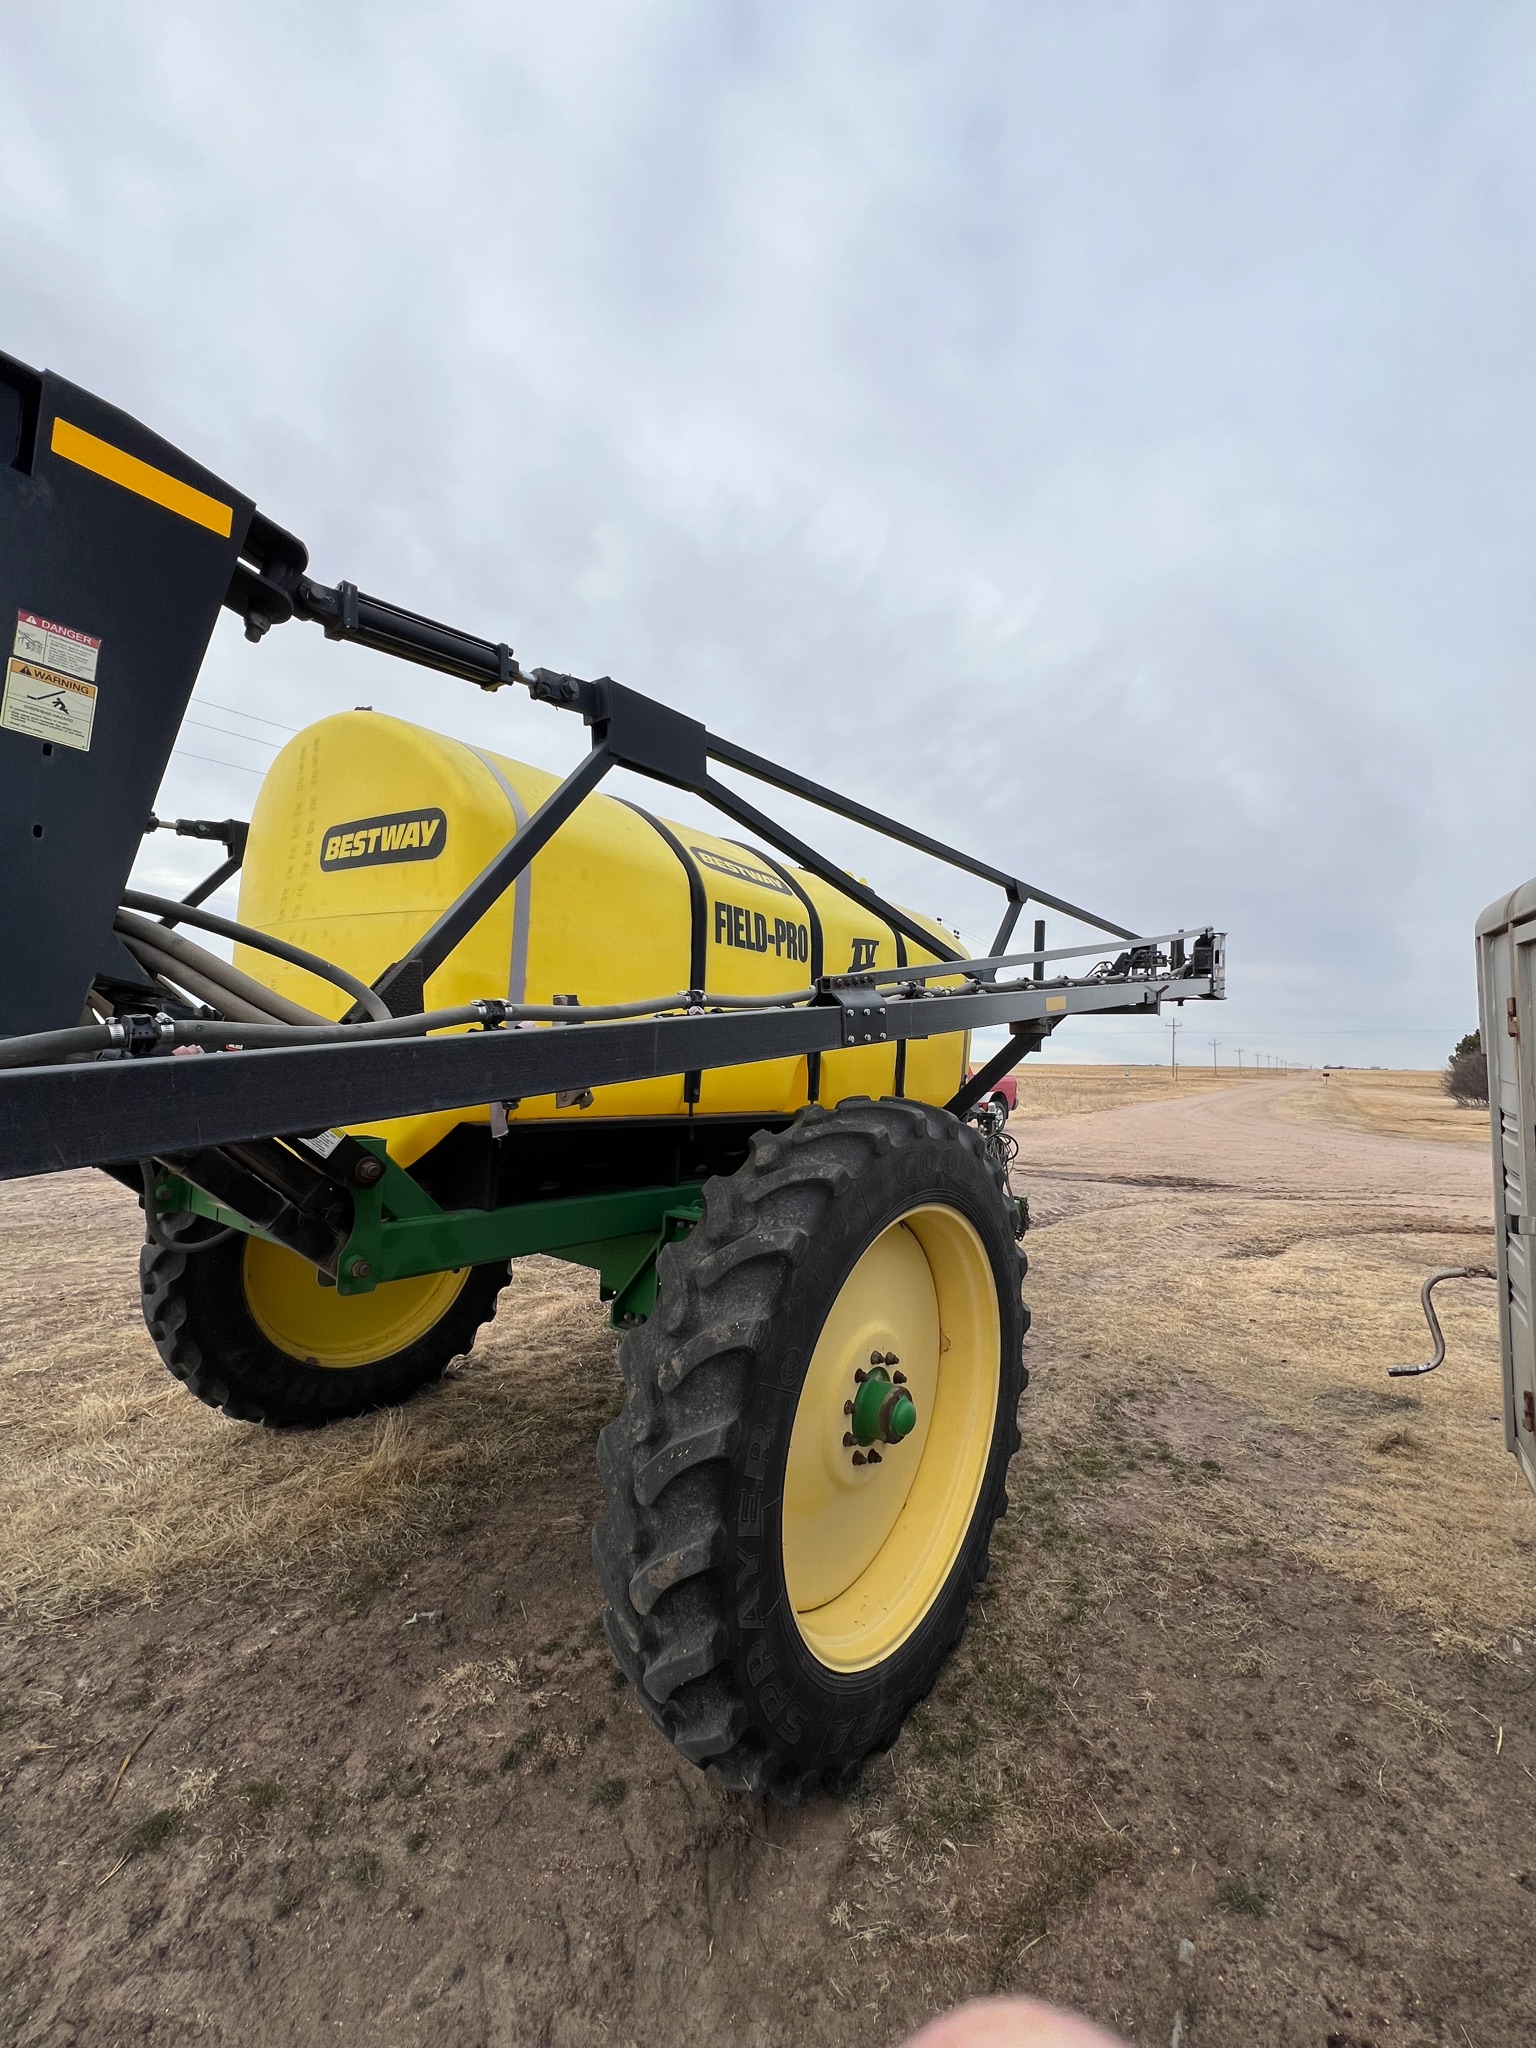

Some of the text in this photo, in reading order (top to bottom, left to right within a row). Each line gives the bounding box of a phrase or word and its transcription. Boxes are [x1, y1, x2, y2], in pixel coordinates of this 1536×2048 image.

[41, 620, 92, 645] DANGER
[34, 669, 89, 695] WARNING
[324, 818, 440, 862] BESTWAY
[699, 851, 785, 890] BESTWAY
[714, 901, 809, 964] FIELD-PRO
[734, 1423, 811, 1746] SPRAYER
